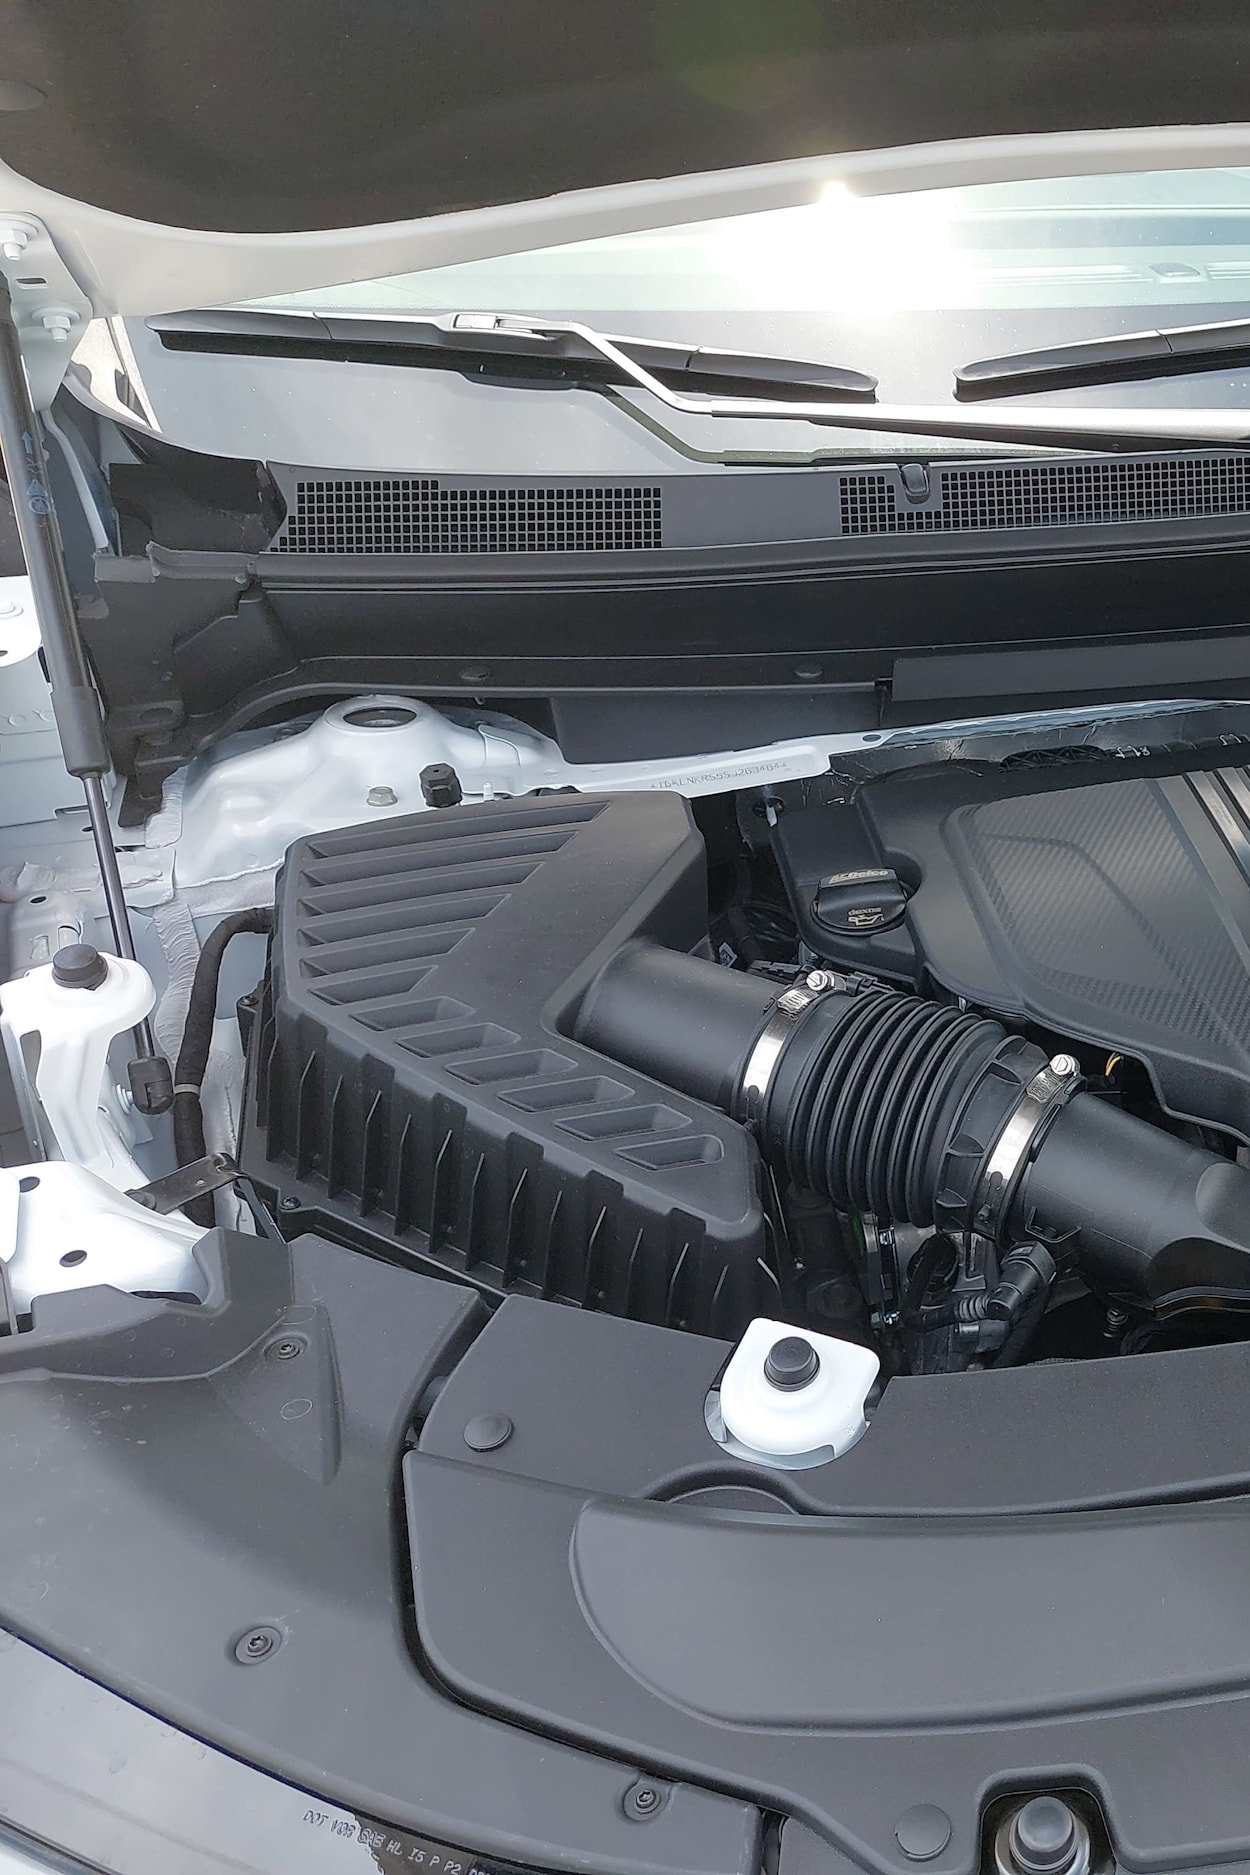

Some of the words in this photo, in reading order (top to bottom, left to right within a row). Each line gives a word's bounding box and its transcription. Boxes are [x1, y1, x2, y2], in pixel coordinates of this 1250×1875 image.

[828, 870, 889, 884] ACDelco
[302, 1809, 329, 1826] DOT
[358, 1827, 386, 1848] SAE
[386, 1840, 402, 1856] HL
[429, 1855, 441, 1868] P
[444, 1860, 462, 1875] P2
